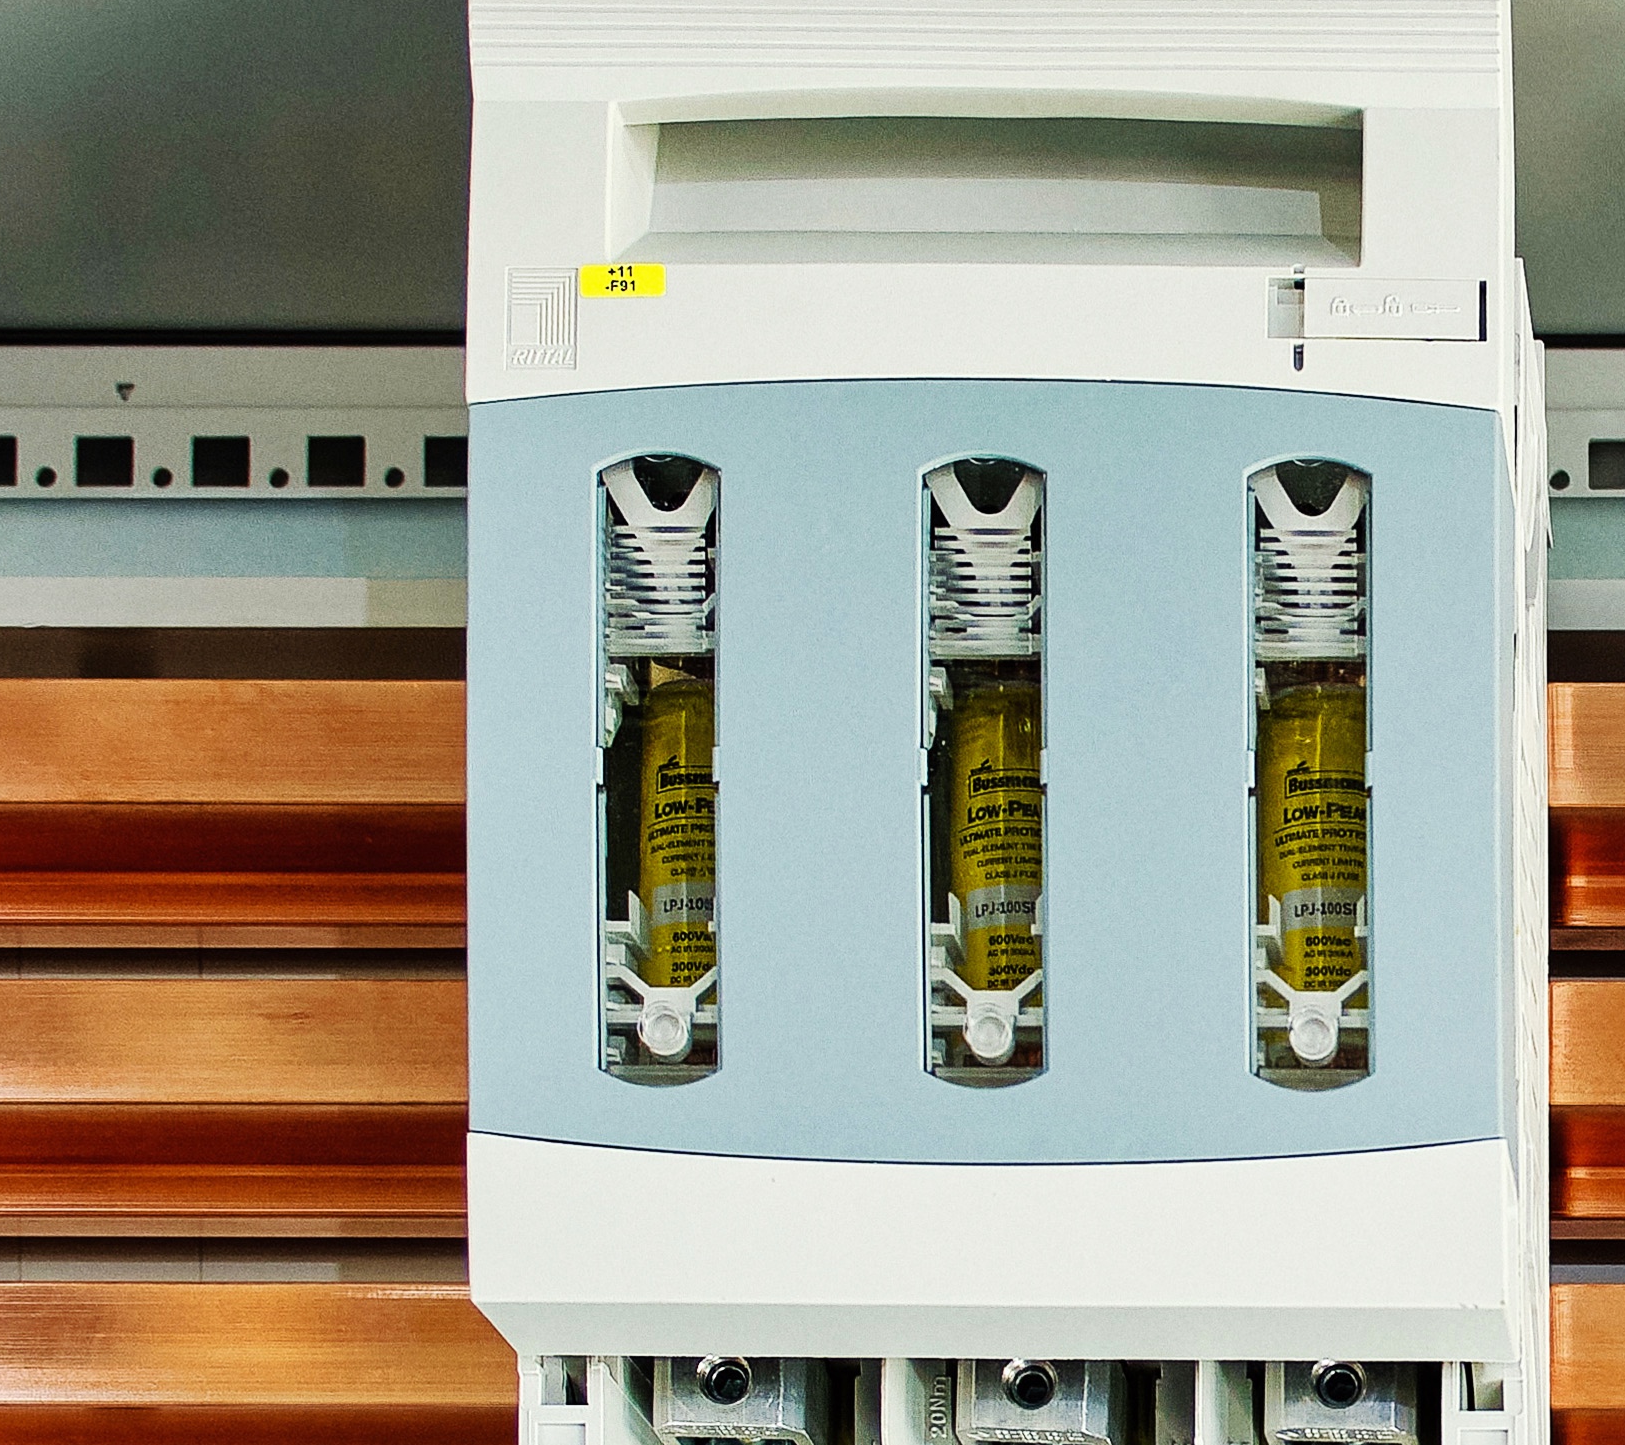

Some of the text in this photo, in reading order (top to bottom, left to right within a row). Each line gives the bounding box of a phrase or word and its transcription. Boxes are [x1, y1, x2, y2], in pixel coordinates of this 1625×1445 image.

[604, 279, 636, 292] -F91
[511, 347, 574, 366] RITTAL
[929, 1376, 949, 1440] 20Nm
